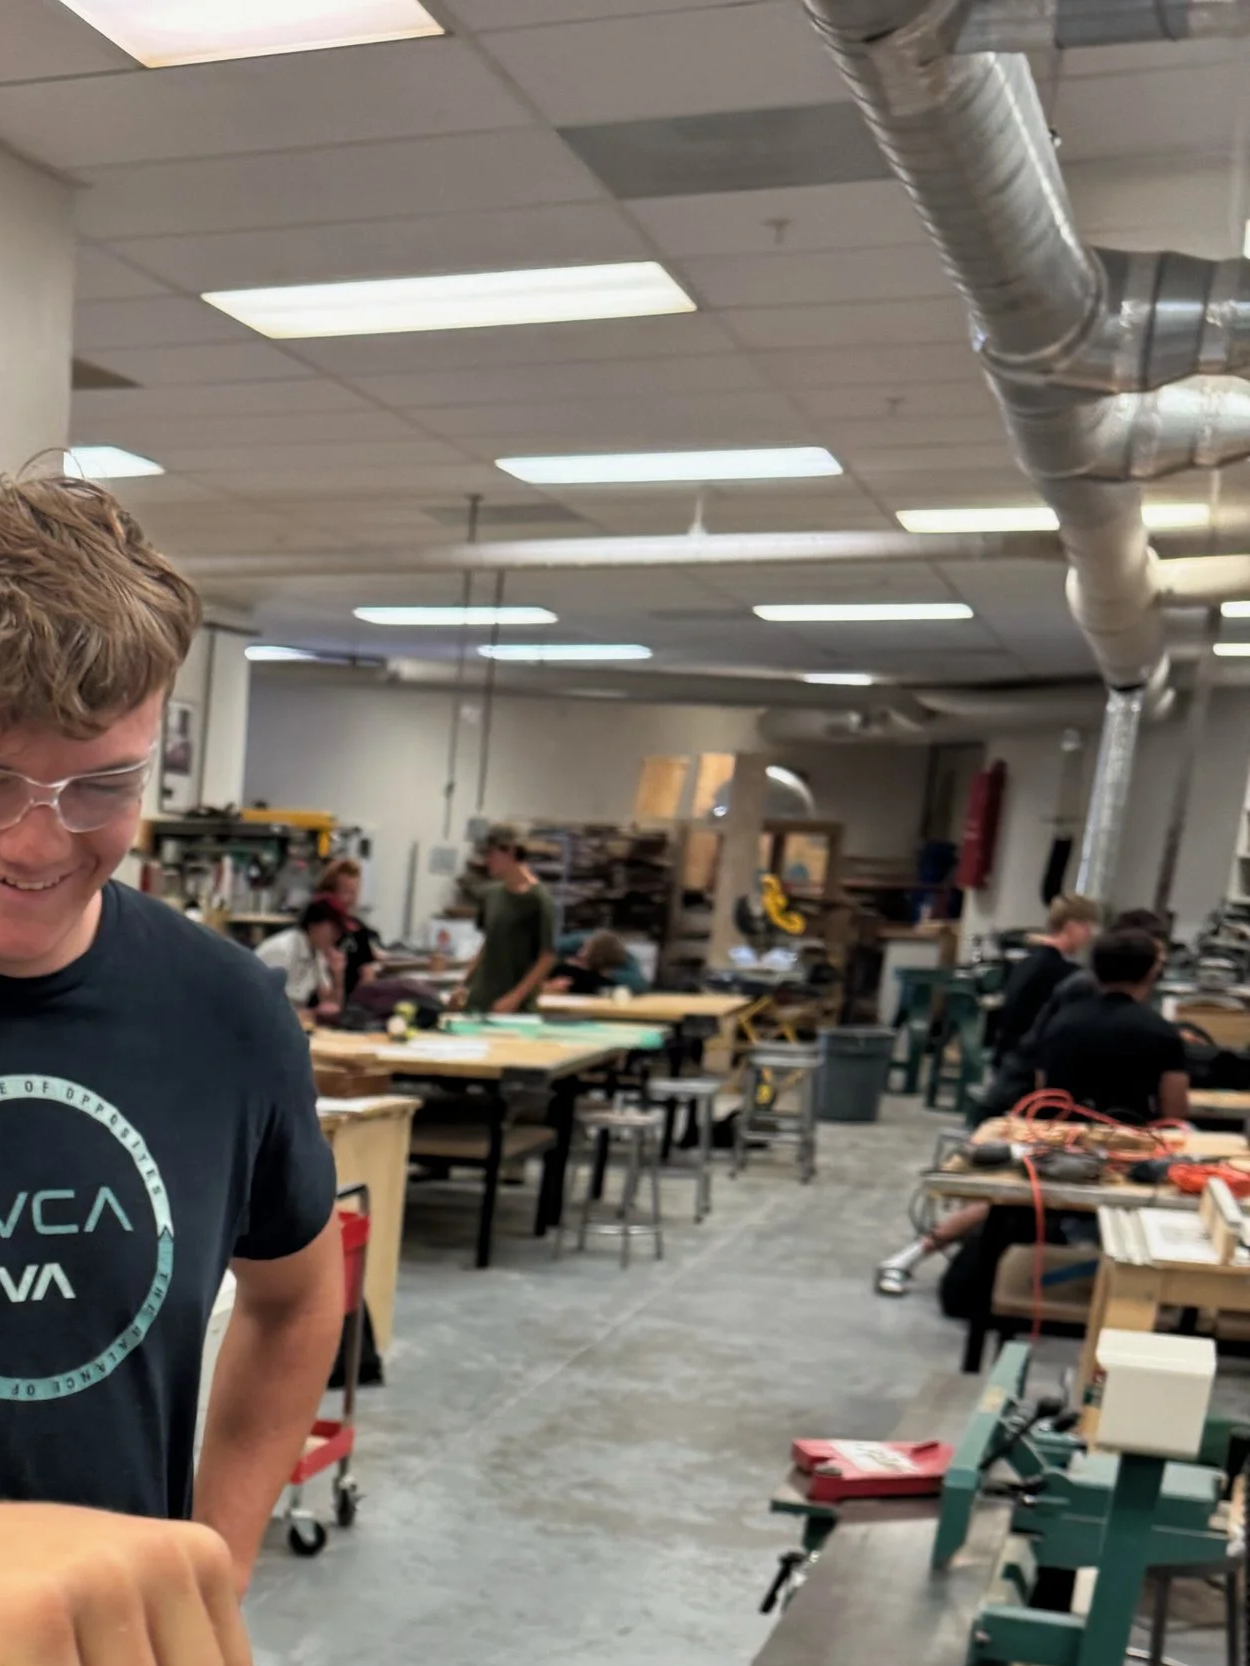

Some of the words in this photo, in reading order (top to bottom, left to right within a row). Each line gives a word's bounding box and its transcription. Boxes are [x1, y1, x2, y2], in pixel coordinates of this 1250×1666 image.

[25, 1080, 51, 1094] OF
[66, 1087, 163, 1196] OPPOSITES
[11, 1384, 36, 1397] OF
